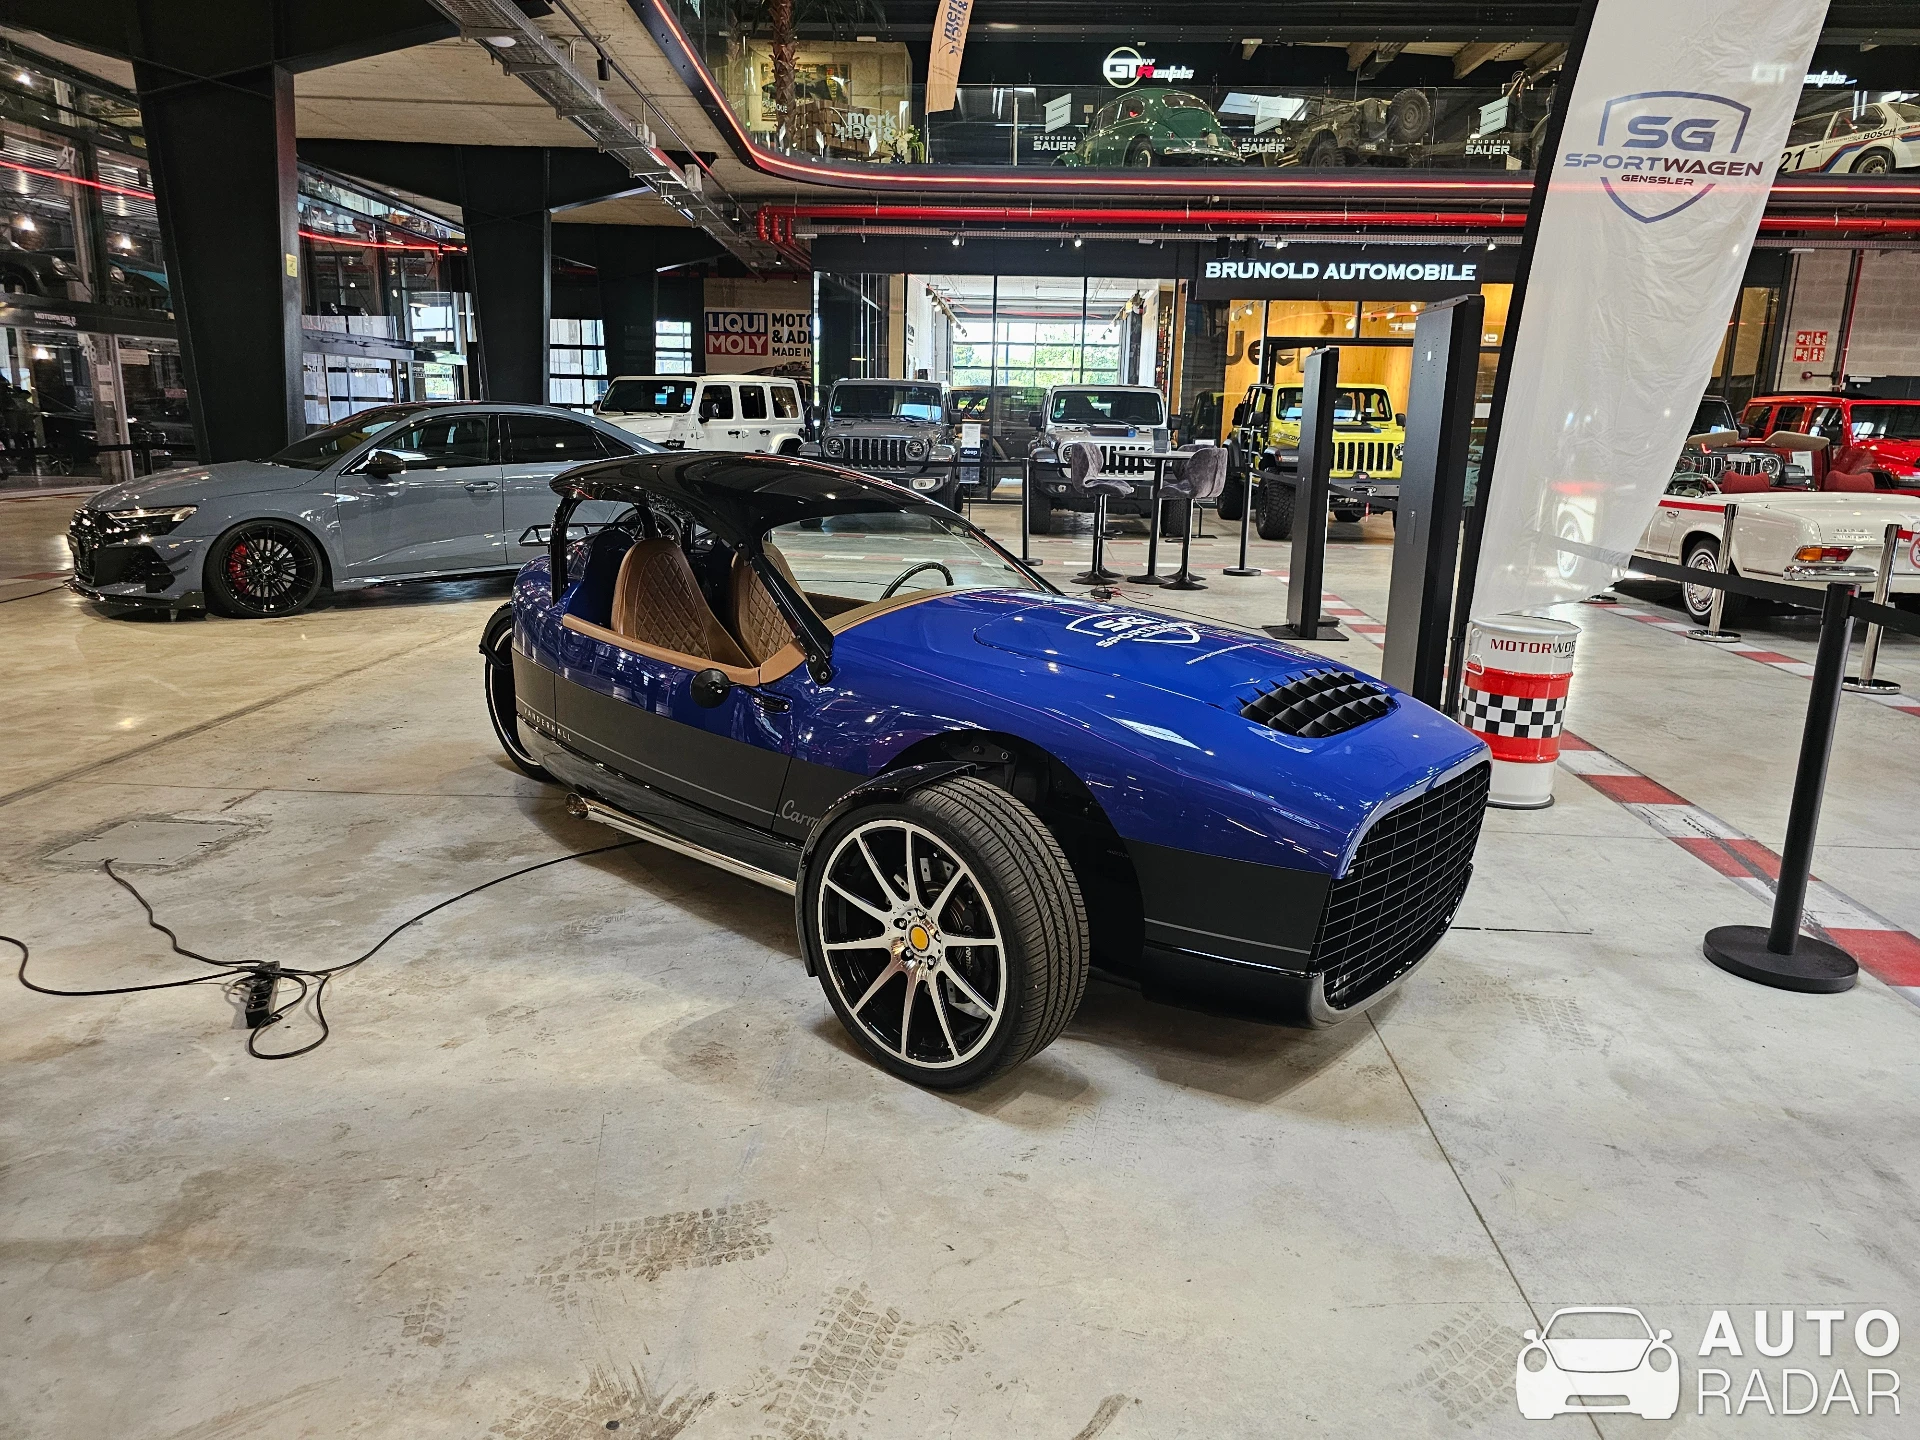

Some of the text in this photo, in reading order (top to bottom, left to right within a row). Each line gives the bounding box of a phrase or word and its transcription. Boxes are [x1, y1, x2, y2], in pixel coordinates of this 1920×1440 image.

[943, 0, 959, 41] mer
[1804, 70, 1848, 88] entals
[847, 110, 897, 131] merk
[1621, 115, 1720, 153] SG
[1863, 128, 1897, 140] BOSCH
[1033, 141, 1077, 151] SAUER
[1241, 143, 1286, 153] SAUER
[1465, 145, 1511, 155] SAUER
[1563, 153, 1764, 177] SPORTWAGEN
[1778, 148, 1806, 172] 21
[1621, 174, 1695, 187] GENSSLER
[1205, 262, 1477, 281] BRUNOLD AUTOMOBILE
[708, 313, 765, 333] LIQUI
[708, 334, 767, 354] MOLY
[772, 330, 783, 344] &
[772, 347, 801, 357] MADE
[1490, 638, 1575, 654] MOTORWOR
[523, 706, 572, 742] VANDERHALL
[781, 799, 821, 828] Carm
